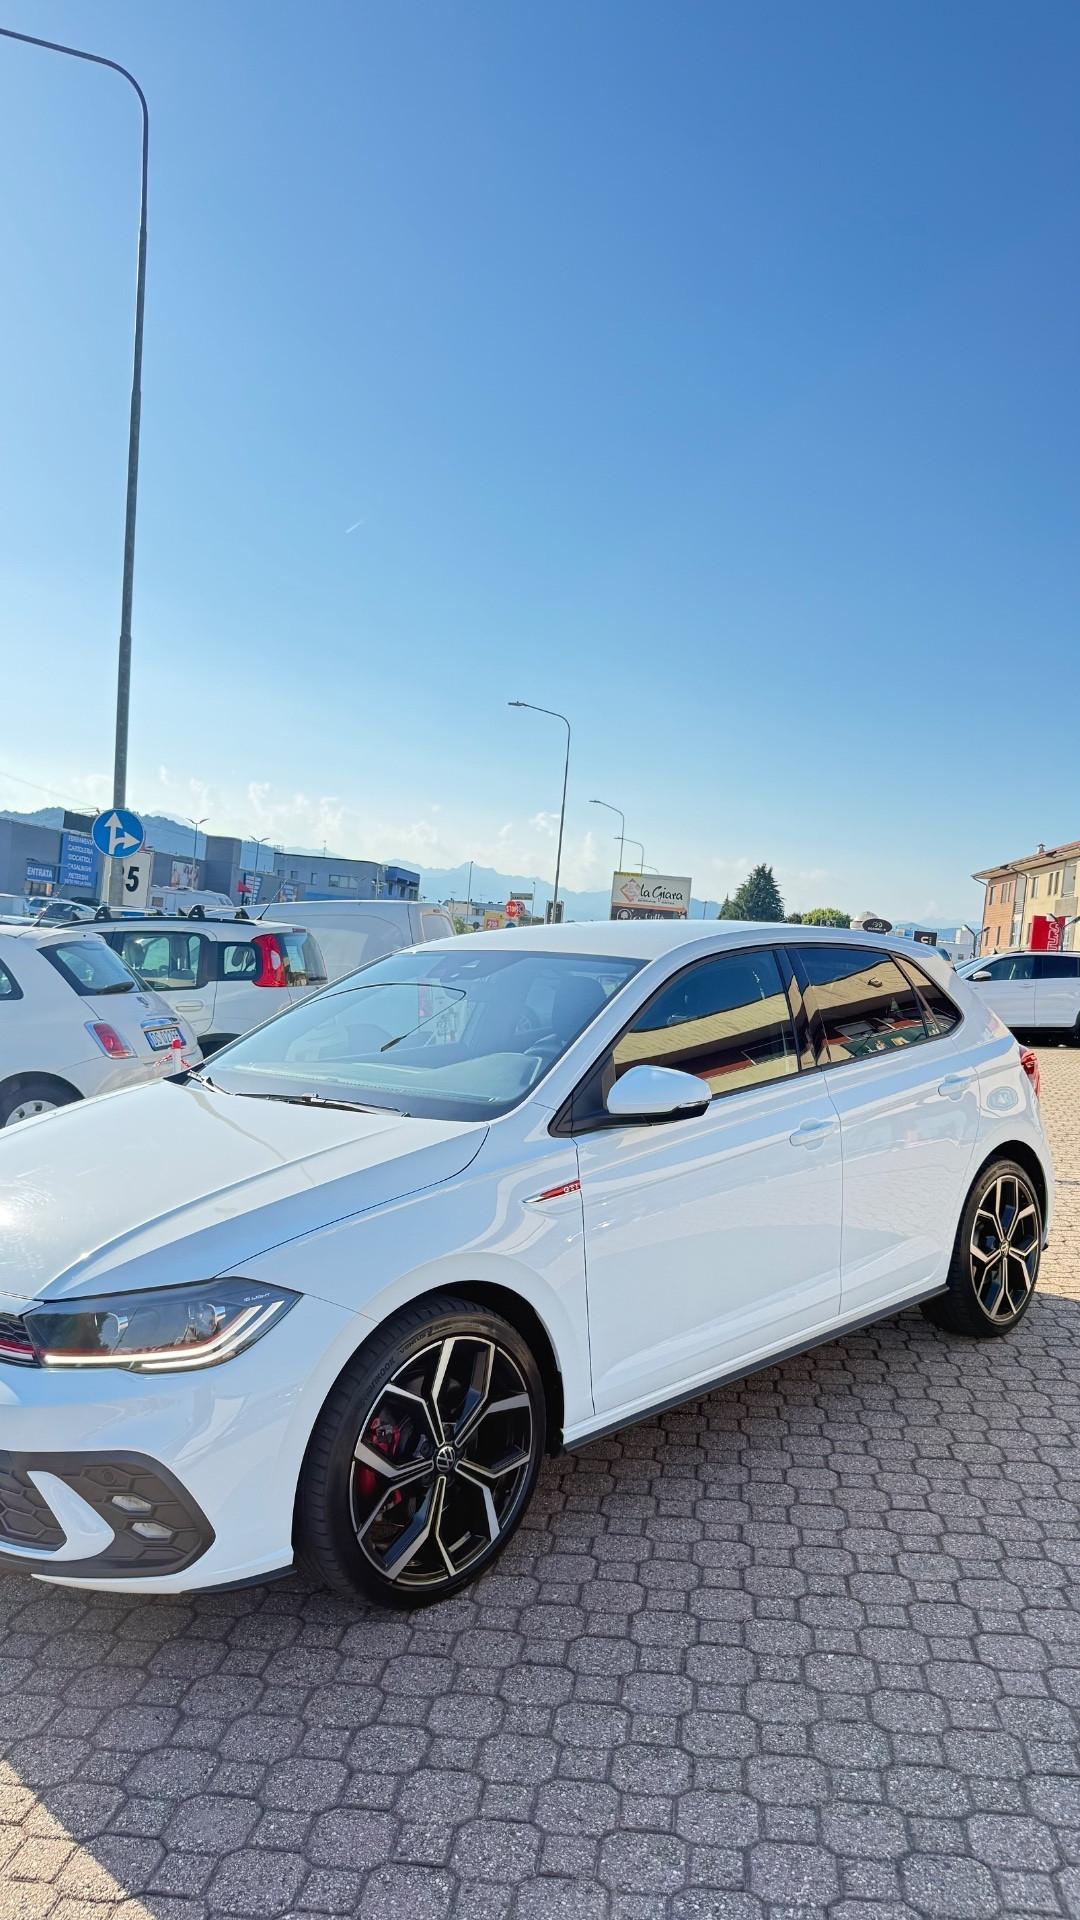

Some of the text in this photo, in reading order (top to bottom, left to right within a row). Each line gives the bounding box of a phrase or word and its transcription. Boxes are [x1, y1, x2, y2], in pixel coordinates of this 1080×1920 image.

[27, 866, 53, 878] ENTRATA
[125, 866, 140, 892] 5
[640, 883, 651, 898] la
[652, 885, 683, 902] Giara
[563, 1183, 579, 1193] GTI
